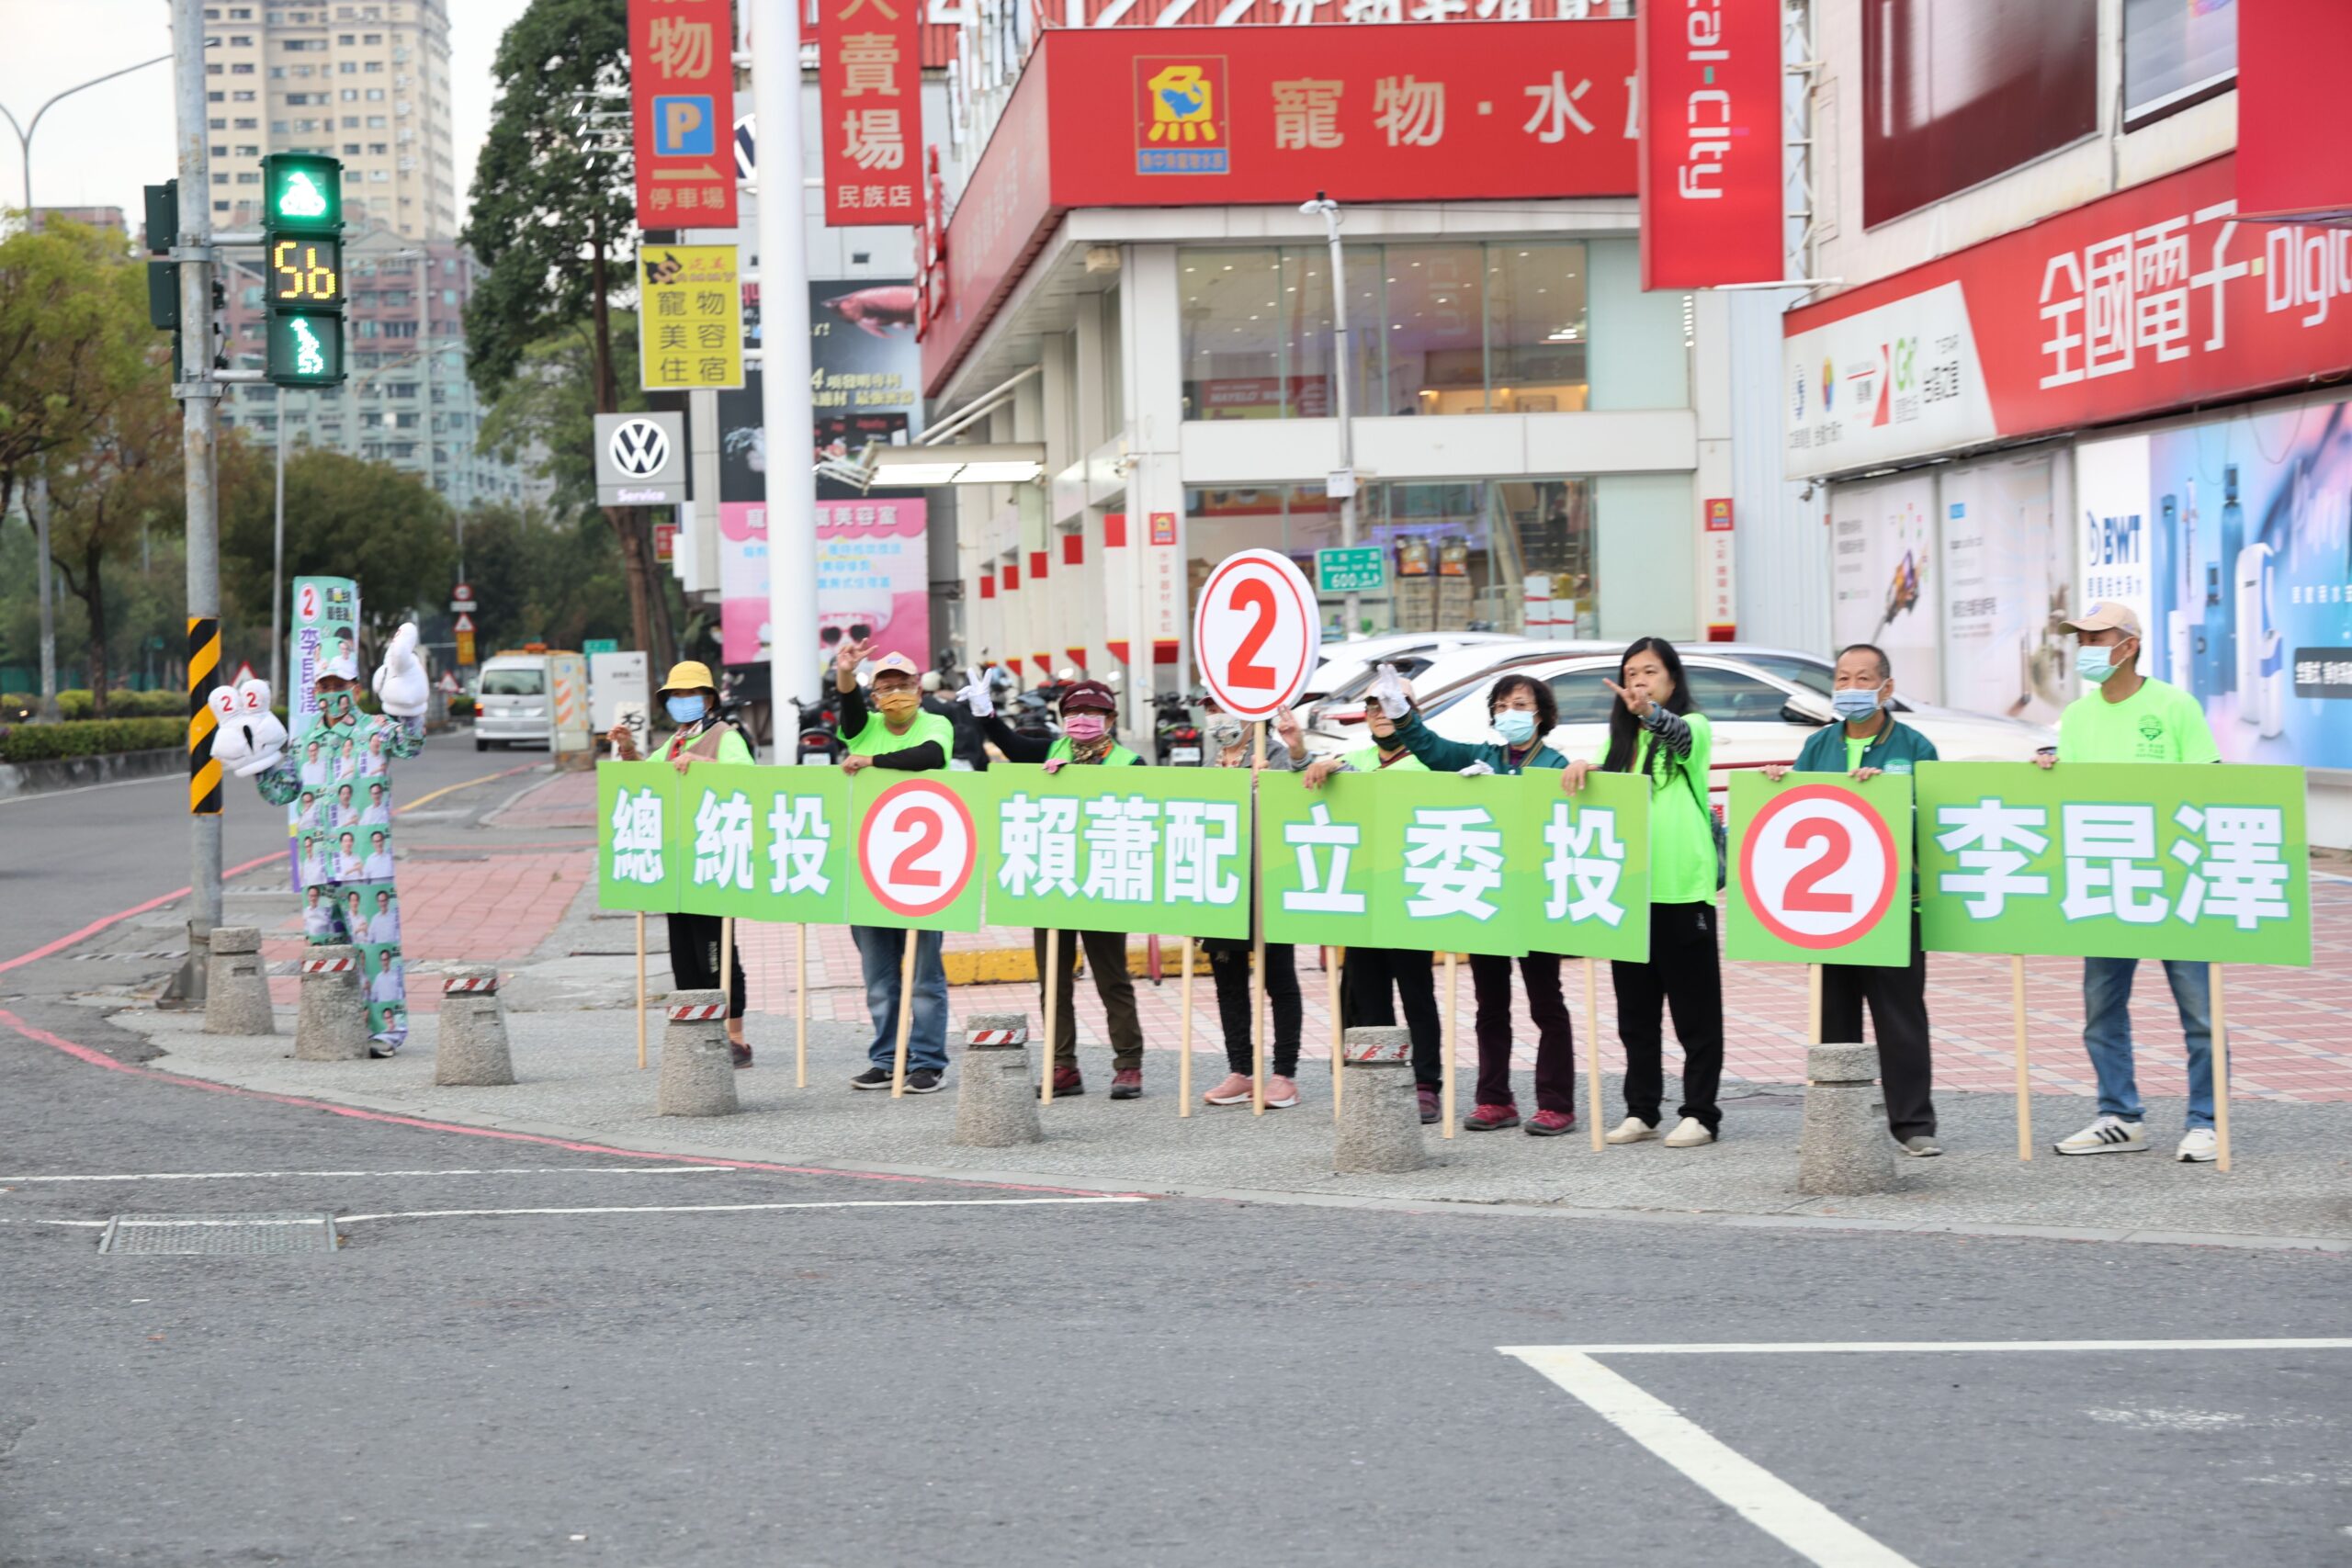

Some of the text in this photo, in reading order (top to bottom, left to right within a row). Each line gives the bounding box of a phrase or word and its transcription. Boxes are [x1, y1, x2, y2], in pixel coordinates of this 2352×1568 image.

[649, 0, 713, 80] 物
[1678, 0, 1750, 199] al-City
[665, 102, 702, 150] P
[649, 186, 726, 211] 停車場
[837, 184, 912, 209] 民族店
[274, 241, 336, 299] 56
[657, 289, 726, 317] 寵物
[2038, 198, 2249, 390] 全國電子
[659, 323, 728, 350] 美容
[660, 355, 729, 384] 住宿
[616, 488, 666, 502] Service
[2103, 514, 2141, 565] BWT
[303, 588, 314, 616] 2
[1227, 577, 1277, 690] 2
[220, 692, 258, 712] 2 2
[611, 786, 2290, 931] 總統投 2 賴蕭配 立委投 2 李昆澤
